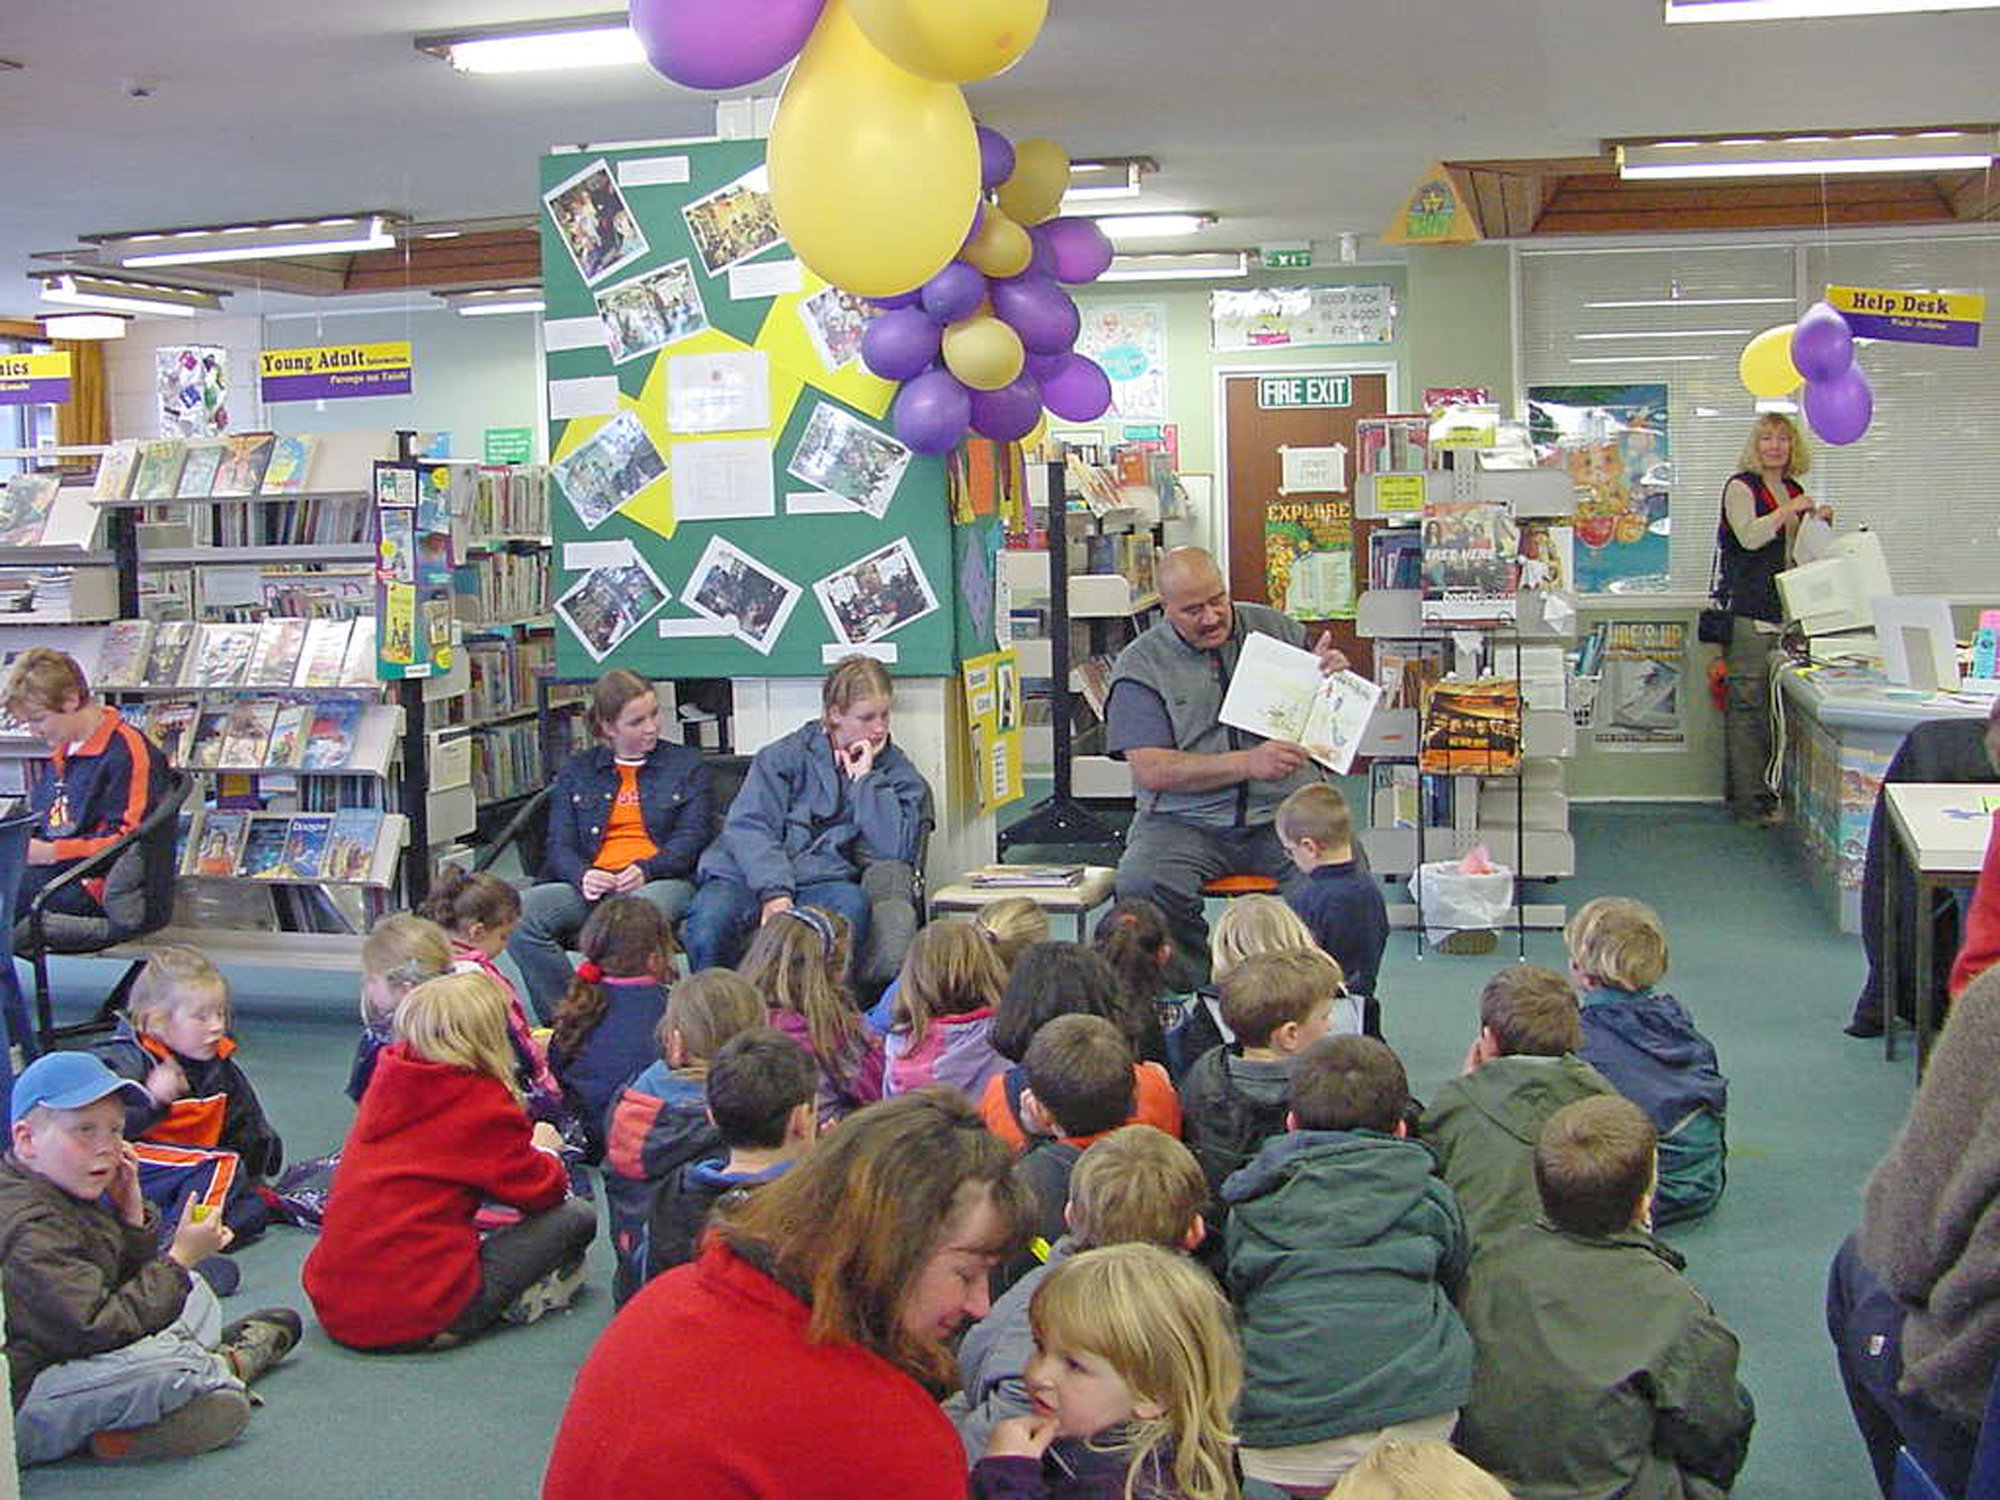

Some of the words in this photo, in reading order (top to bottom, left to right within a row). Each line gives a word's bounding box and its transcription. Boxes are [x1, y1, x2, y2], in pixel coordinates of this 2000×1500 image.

[1853, 293, 1896, 312] Help
[1903, 296, 1949, 314] Desk
[264, 355, 313, 373] Young
[318, 350, 364, 368] Adult
[1263, 380, 1302, 405] FIRE
[1306, 379, 1346, 404] EXIT
[1267, 502, 1350, 521] EXPLORE
